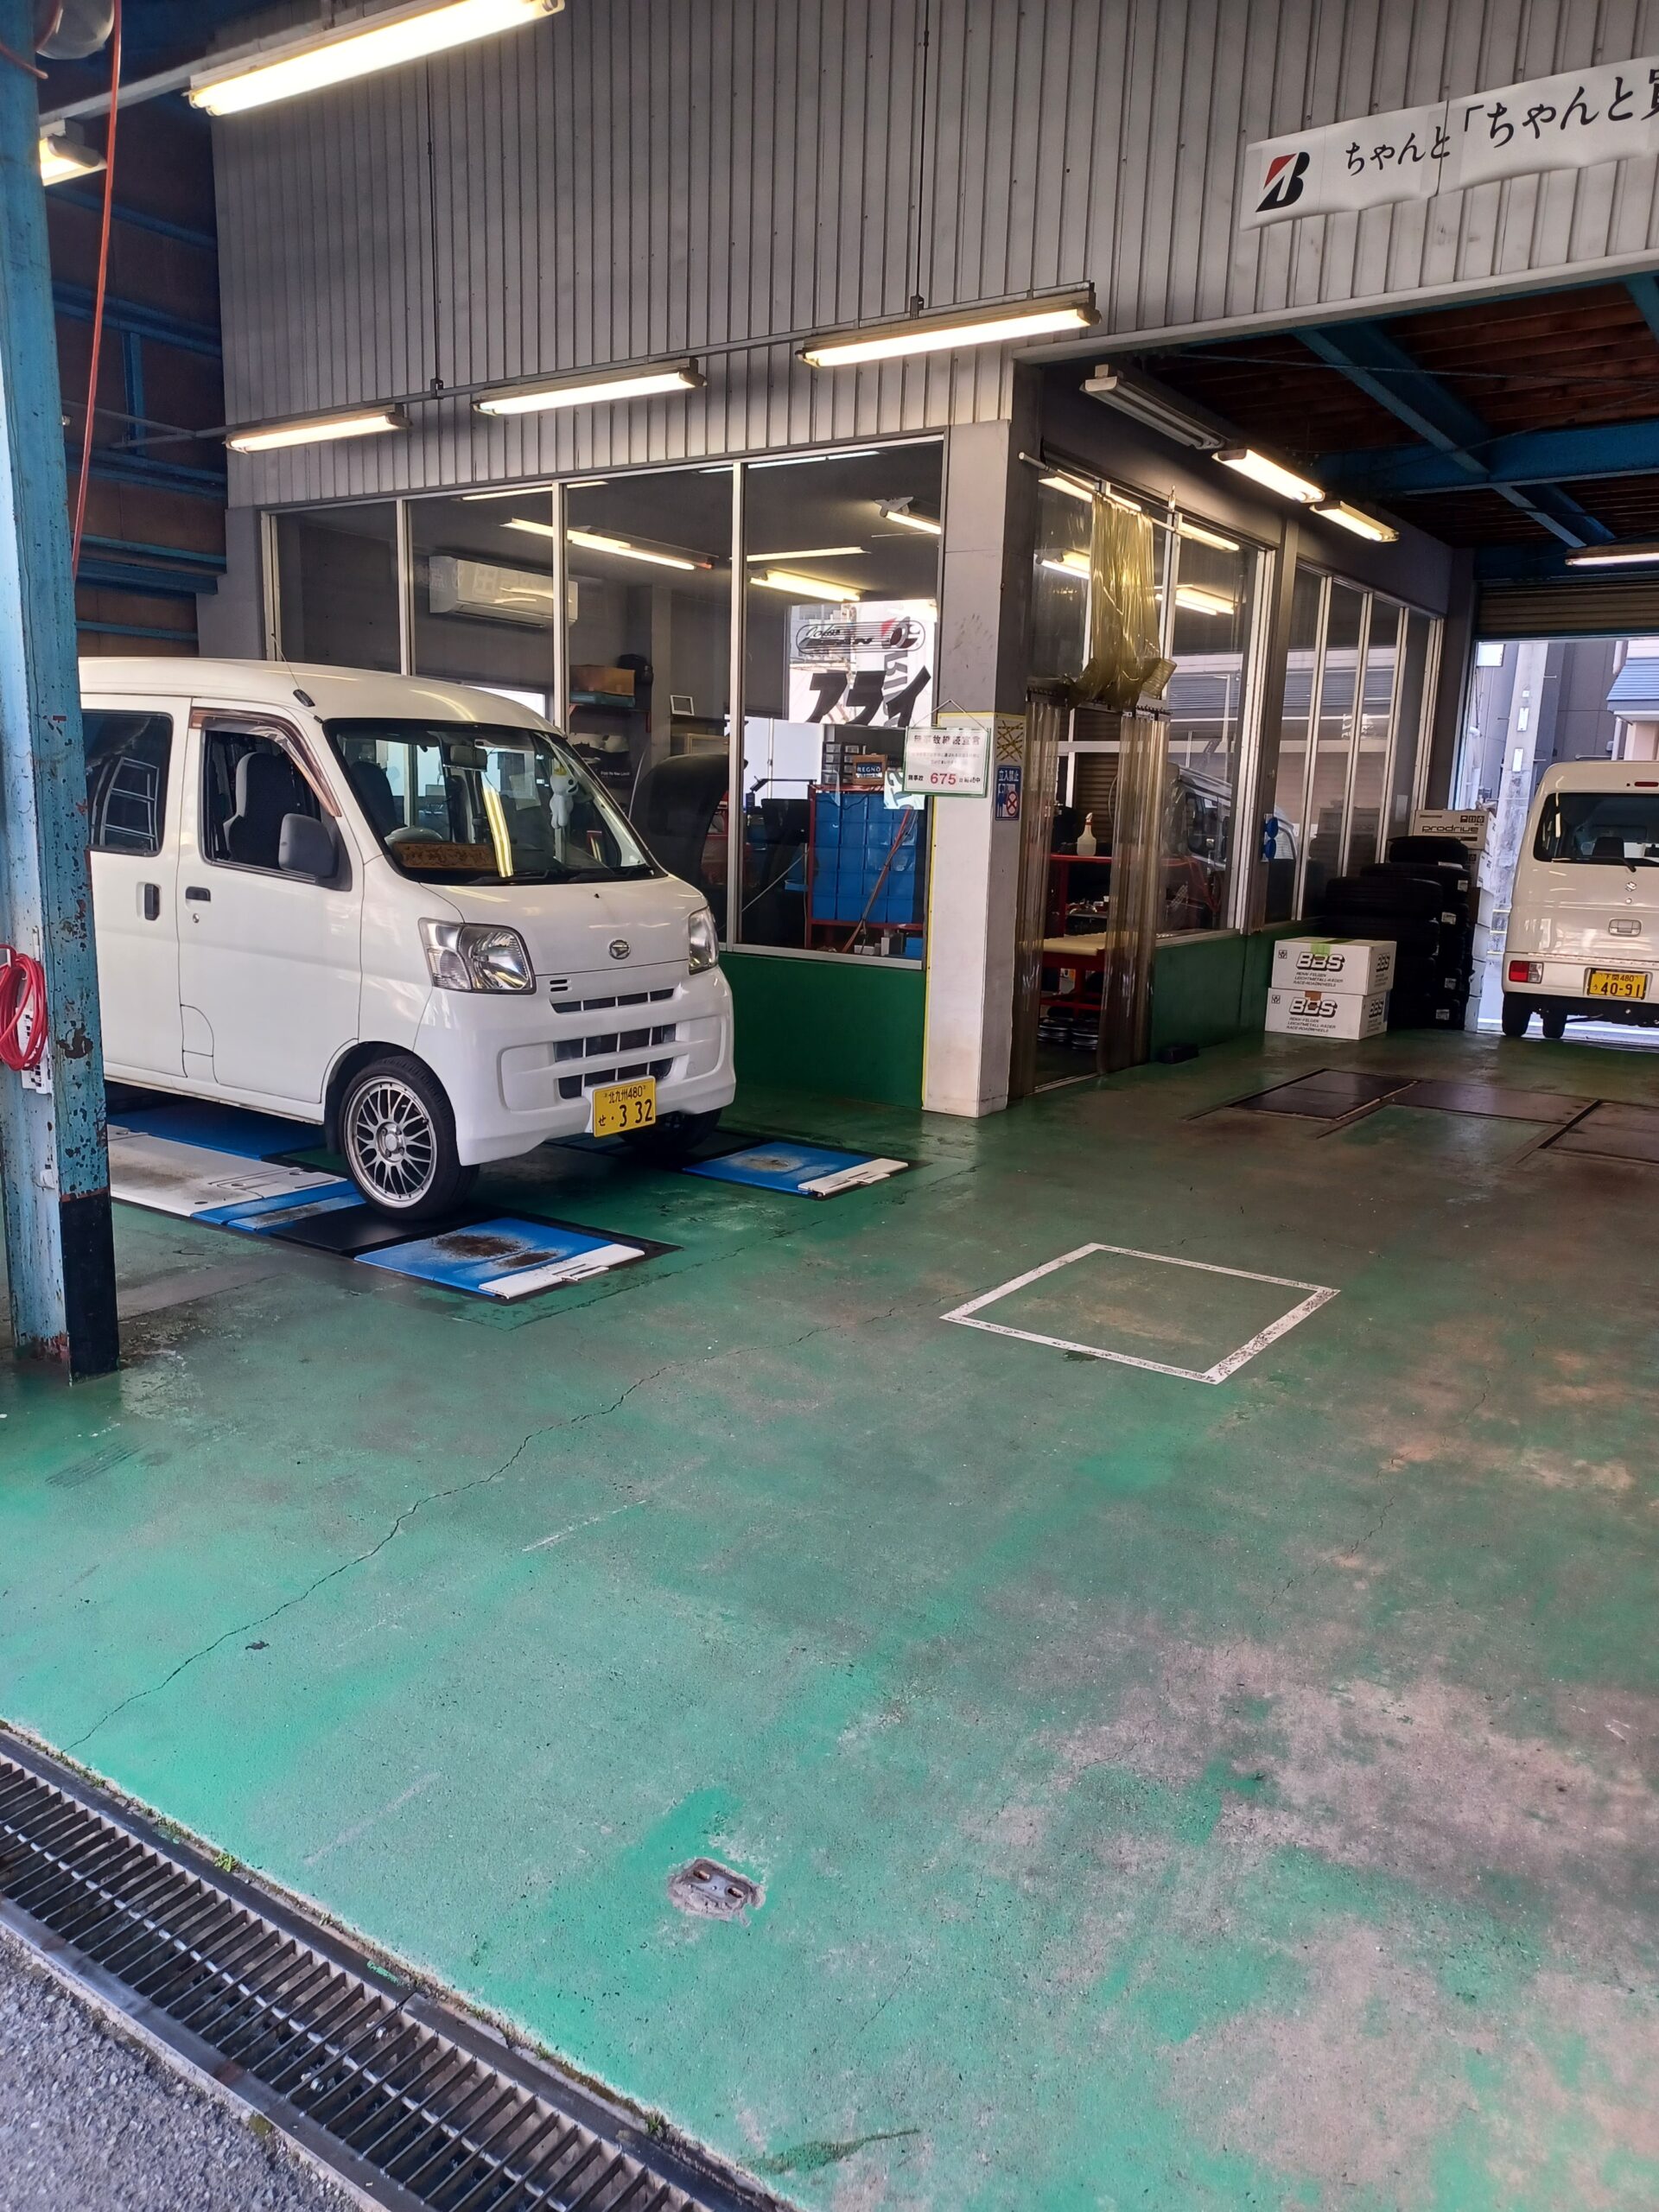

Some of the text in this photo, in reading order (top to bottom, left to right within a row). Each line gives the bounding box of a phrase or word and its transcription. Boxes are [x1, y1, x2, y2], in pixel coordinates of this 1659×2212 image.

[930, 772, 957, 785] 675
[998, 770, 1019, 782] 立入禁止
[1296, 951, 1345, 972] BBS
[1601, 982, 1640, 998] 40-91
[1288, 997, 1338, 1018] BBS
[599, 1115, 606, 1126] せ
